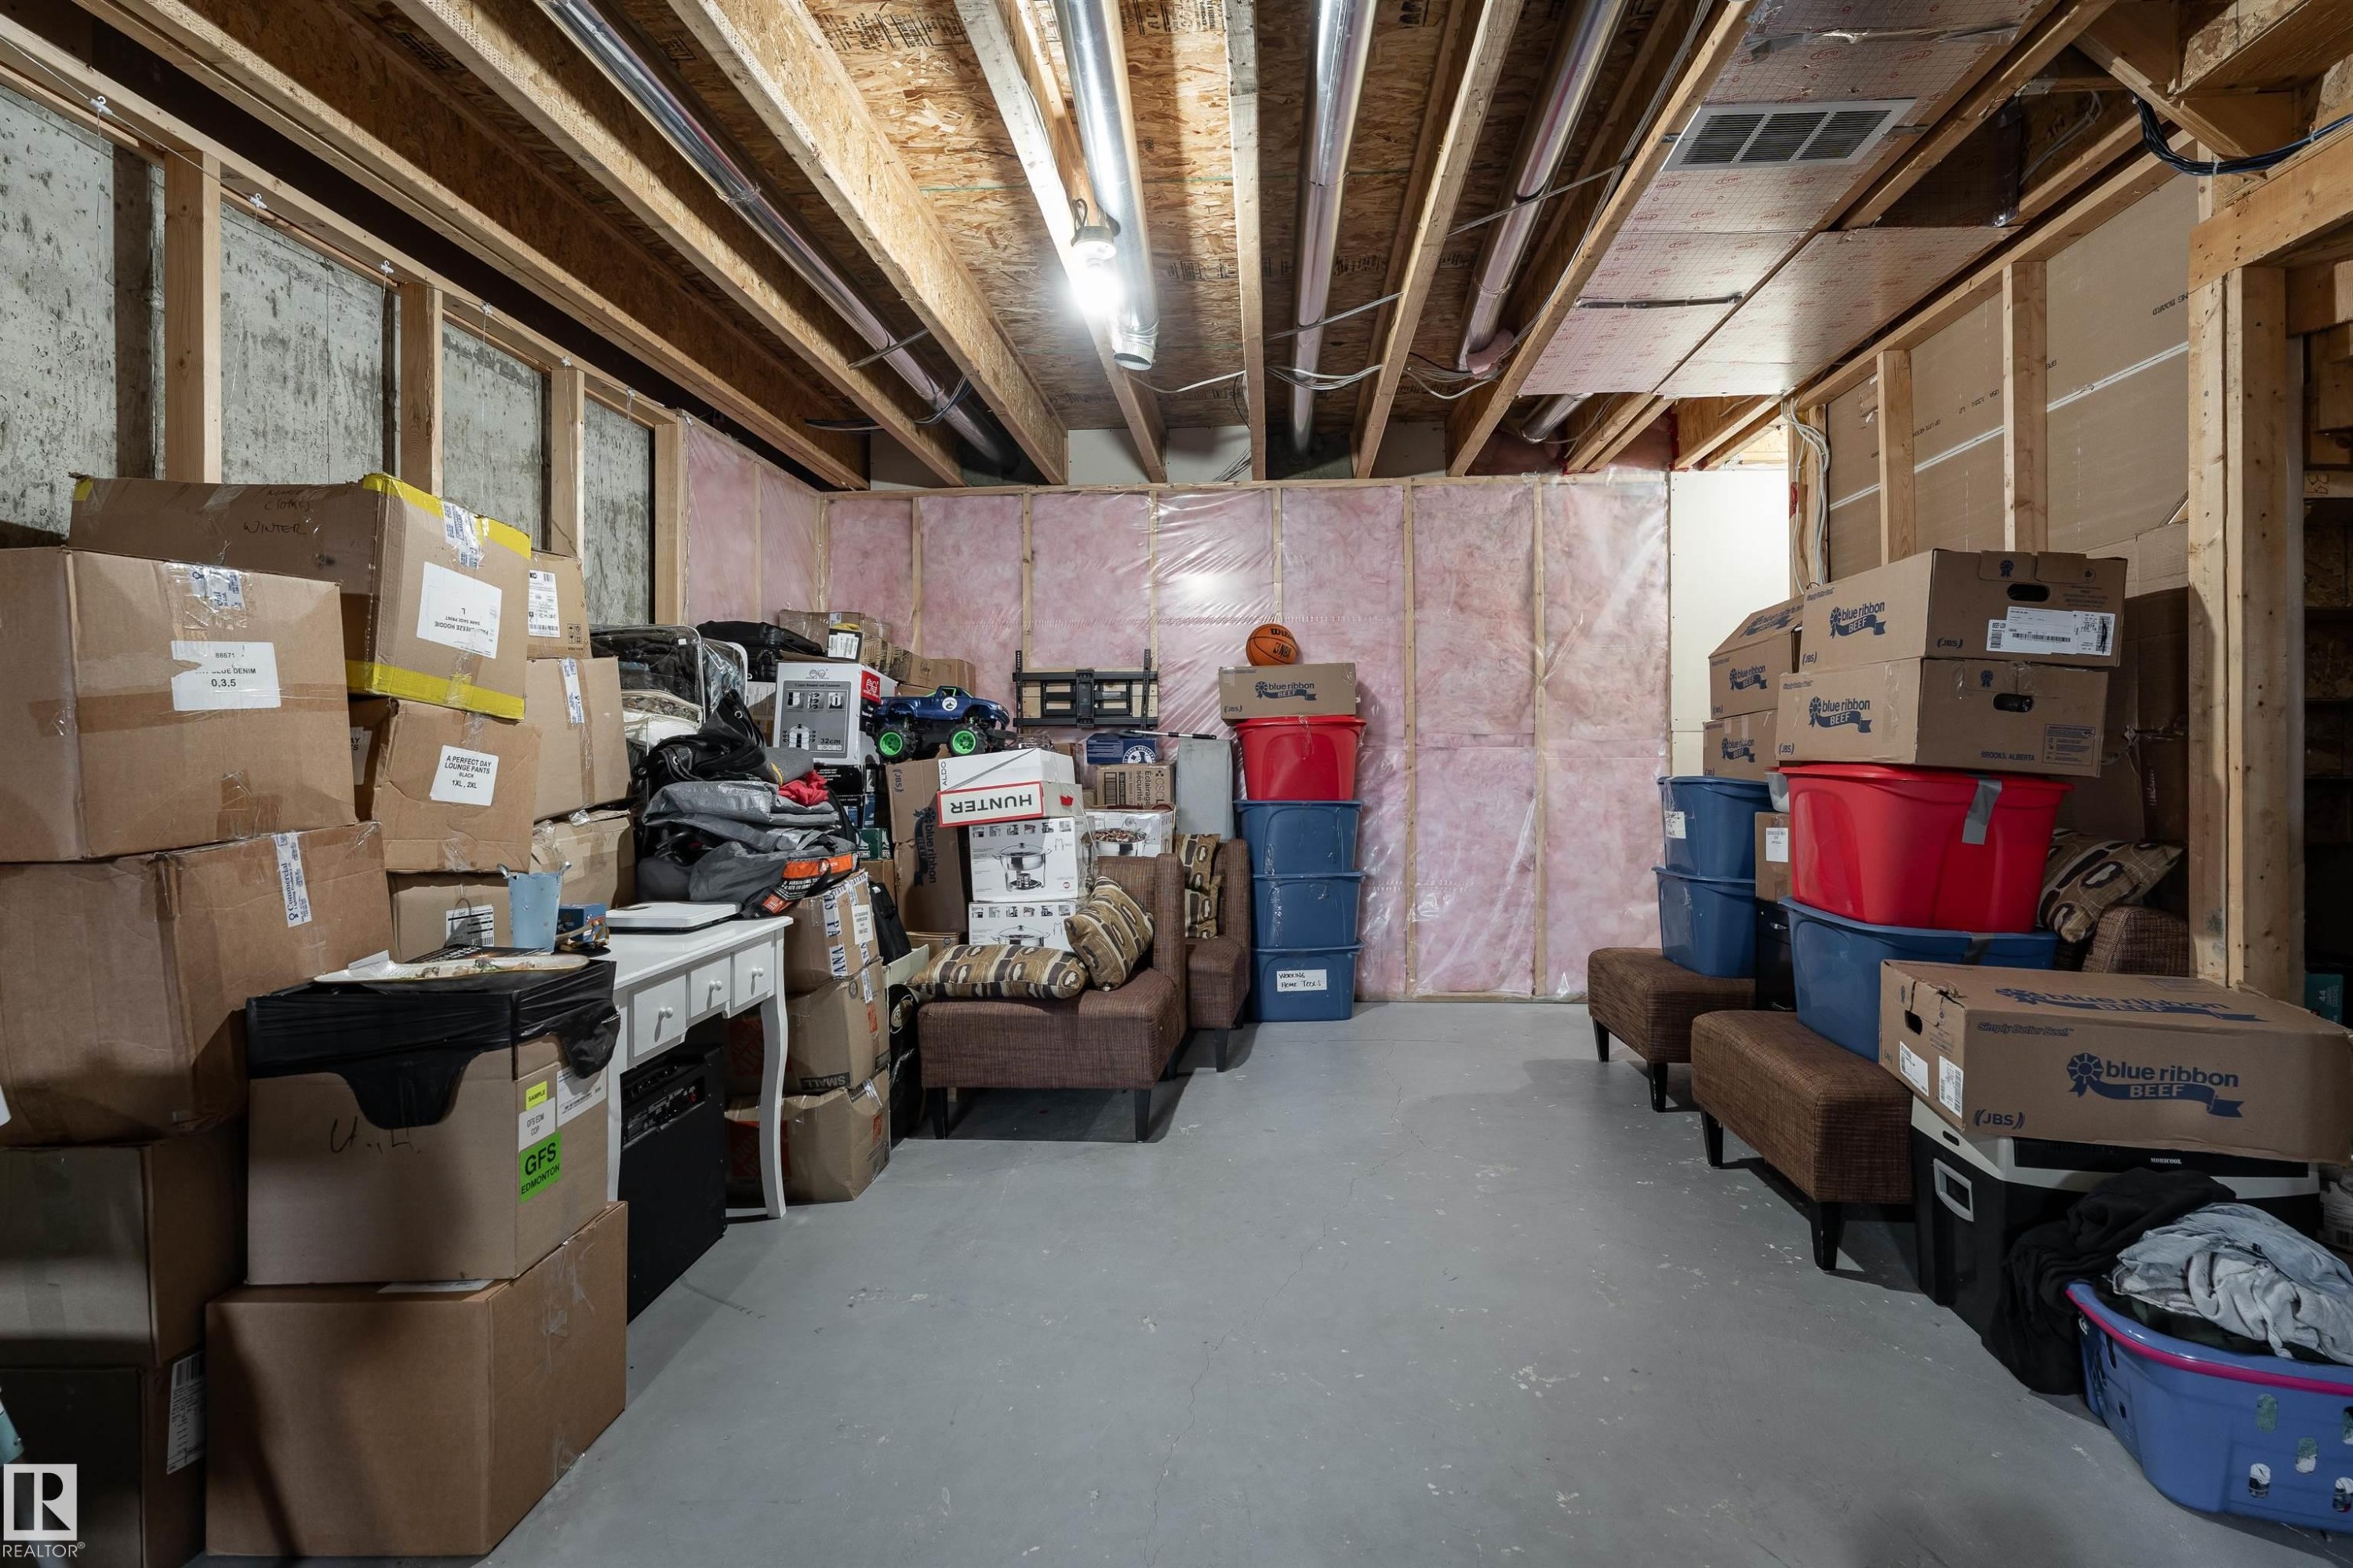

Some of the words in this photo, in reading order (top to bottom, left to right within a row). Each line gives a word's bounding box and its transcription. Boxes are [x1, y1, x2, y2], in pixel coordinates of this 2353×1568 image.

[2152, 299, 2176, 315] BOARD
[244, 520, 307, 535] WINTER
[1842, 609, 1858, 621] blue
[1858, 602, 1885, 617] ribbon
[435, 620, 455, 631] HOODIE
[1848, 618, 1867, 633] BEEF
[1737, 670, 1748, 678] blue
[1748, 665, 1766, 675] ribbon
[211, 678, 236, 687] 0,3,5
[1286, 681, 1315, 690] ribbon
[1822, 700, 1840, 712] blue
[1840, 698, 1871, 710] ribbon
[1830, 713, 1850, 726] BEEF
[445, 762, 470, 771] LOUNGE
[471, 766, 490, 774] PANTS
[452, 756, 478, 766] PERFECT
[480, 759, 492, 768] DAY
[951, 794, 1032, 814] HUNTER
[928, 846, 936, 883] ribbon
[281, 863, 294, 911] Commercial
[2042, 992, 2117, 1004] blue
[2120, 998, 2231, 1010] ribbon
[2319, 990, 2326, 1002] 44
[2096, 1004, 2166, 1013] BEEF
[1977, 1022, 2011, 1034] Simply
[2012, 1024, 2042, 1035] Better
[2106, 1061, 2155, 1081] blue
[2159, 1065, 2239, 1087] ribbon
[805, 1075, 846, 1088] SMALL
[528, 1089, 546, 1103] SAMPLE
[2129, 1084, 2184, 1098] BEEF
[526, 1118, 536, 1129] GFS
[536, 1114, 545, 1124] EDM
[525, 1142, 557, 1176] GFS
[521, 1163, 560, 1195] EDMONTON
